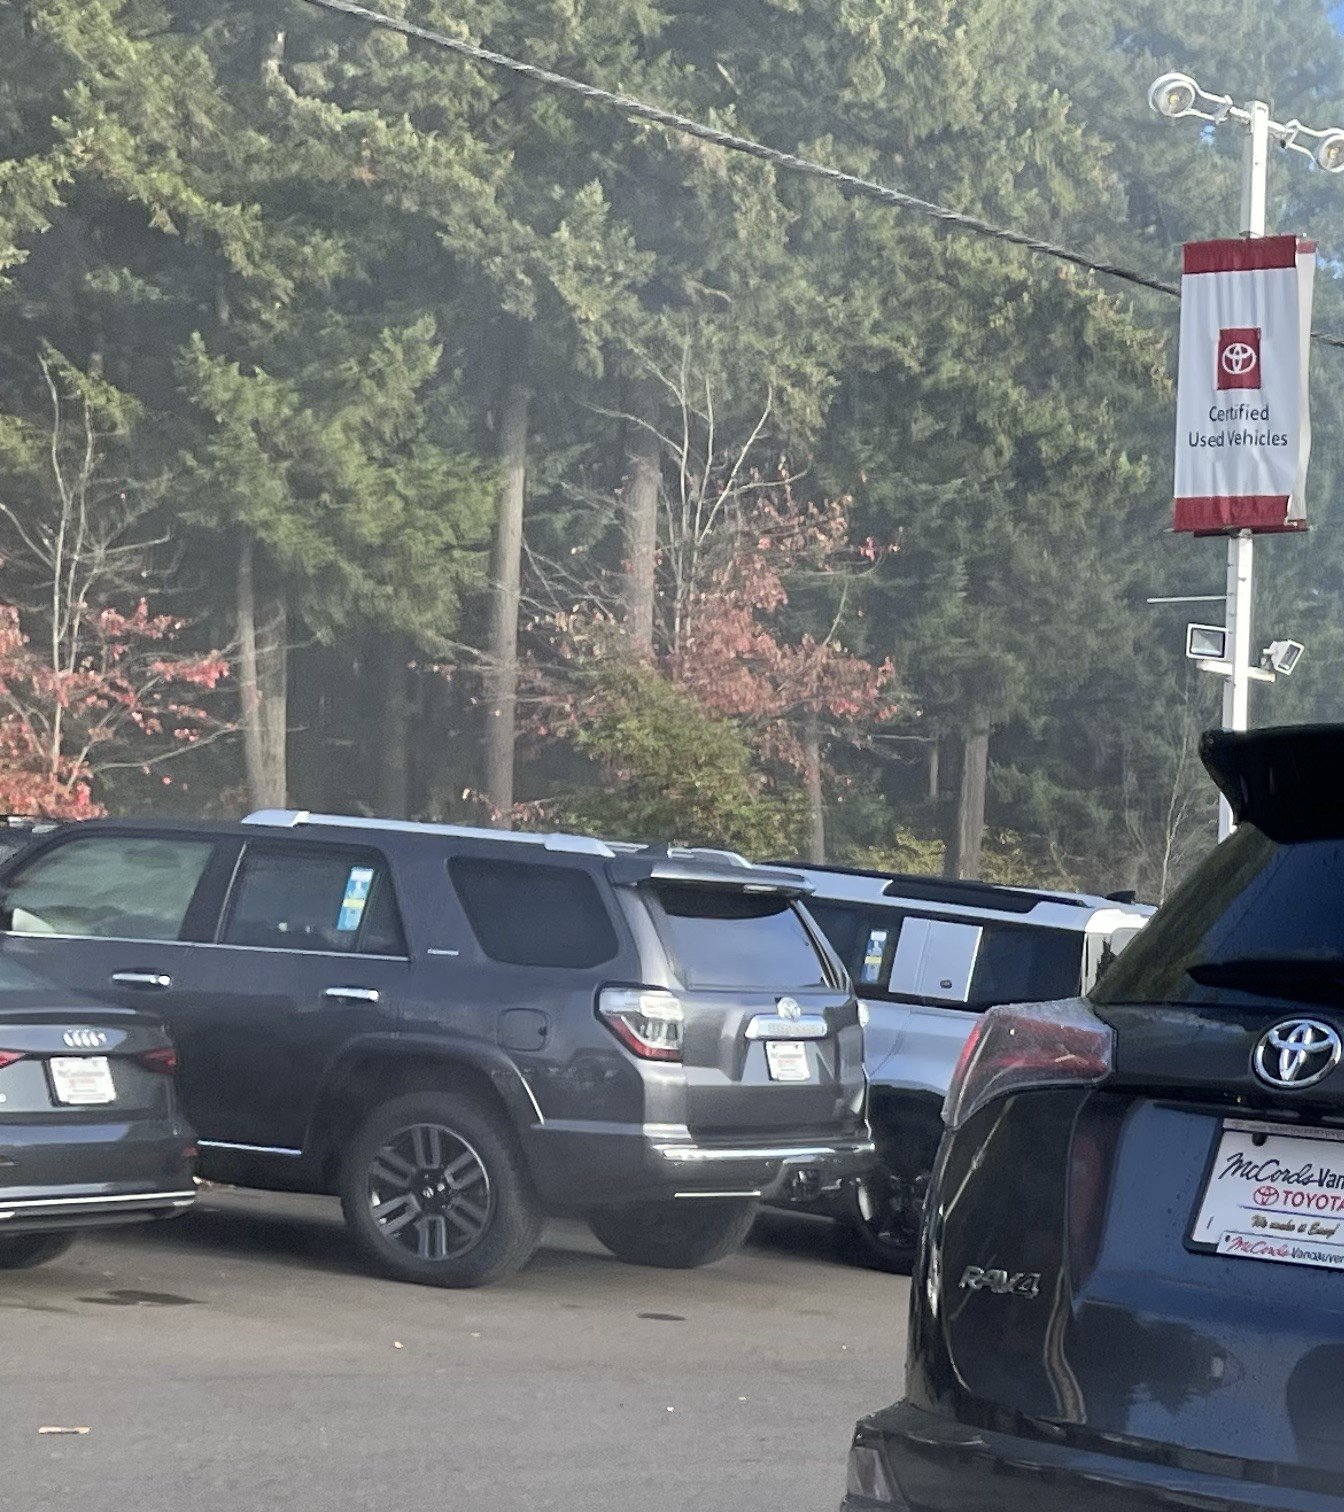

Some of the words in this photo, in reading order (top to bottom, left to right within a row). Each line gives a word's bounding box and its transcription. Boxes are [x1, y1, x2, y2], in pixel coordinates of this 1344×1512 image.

[1209, 404, 1270, 422] Certified
[1188, 430, 1225, 448] Used
[1228, 429, 1288, 448] Vehicles
[958, 1265, 1042, 1299] RAV4
